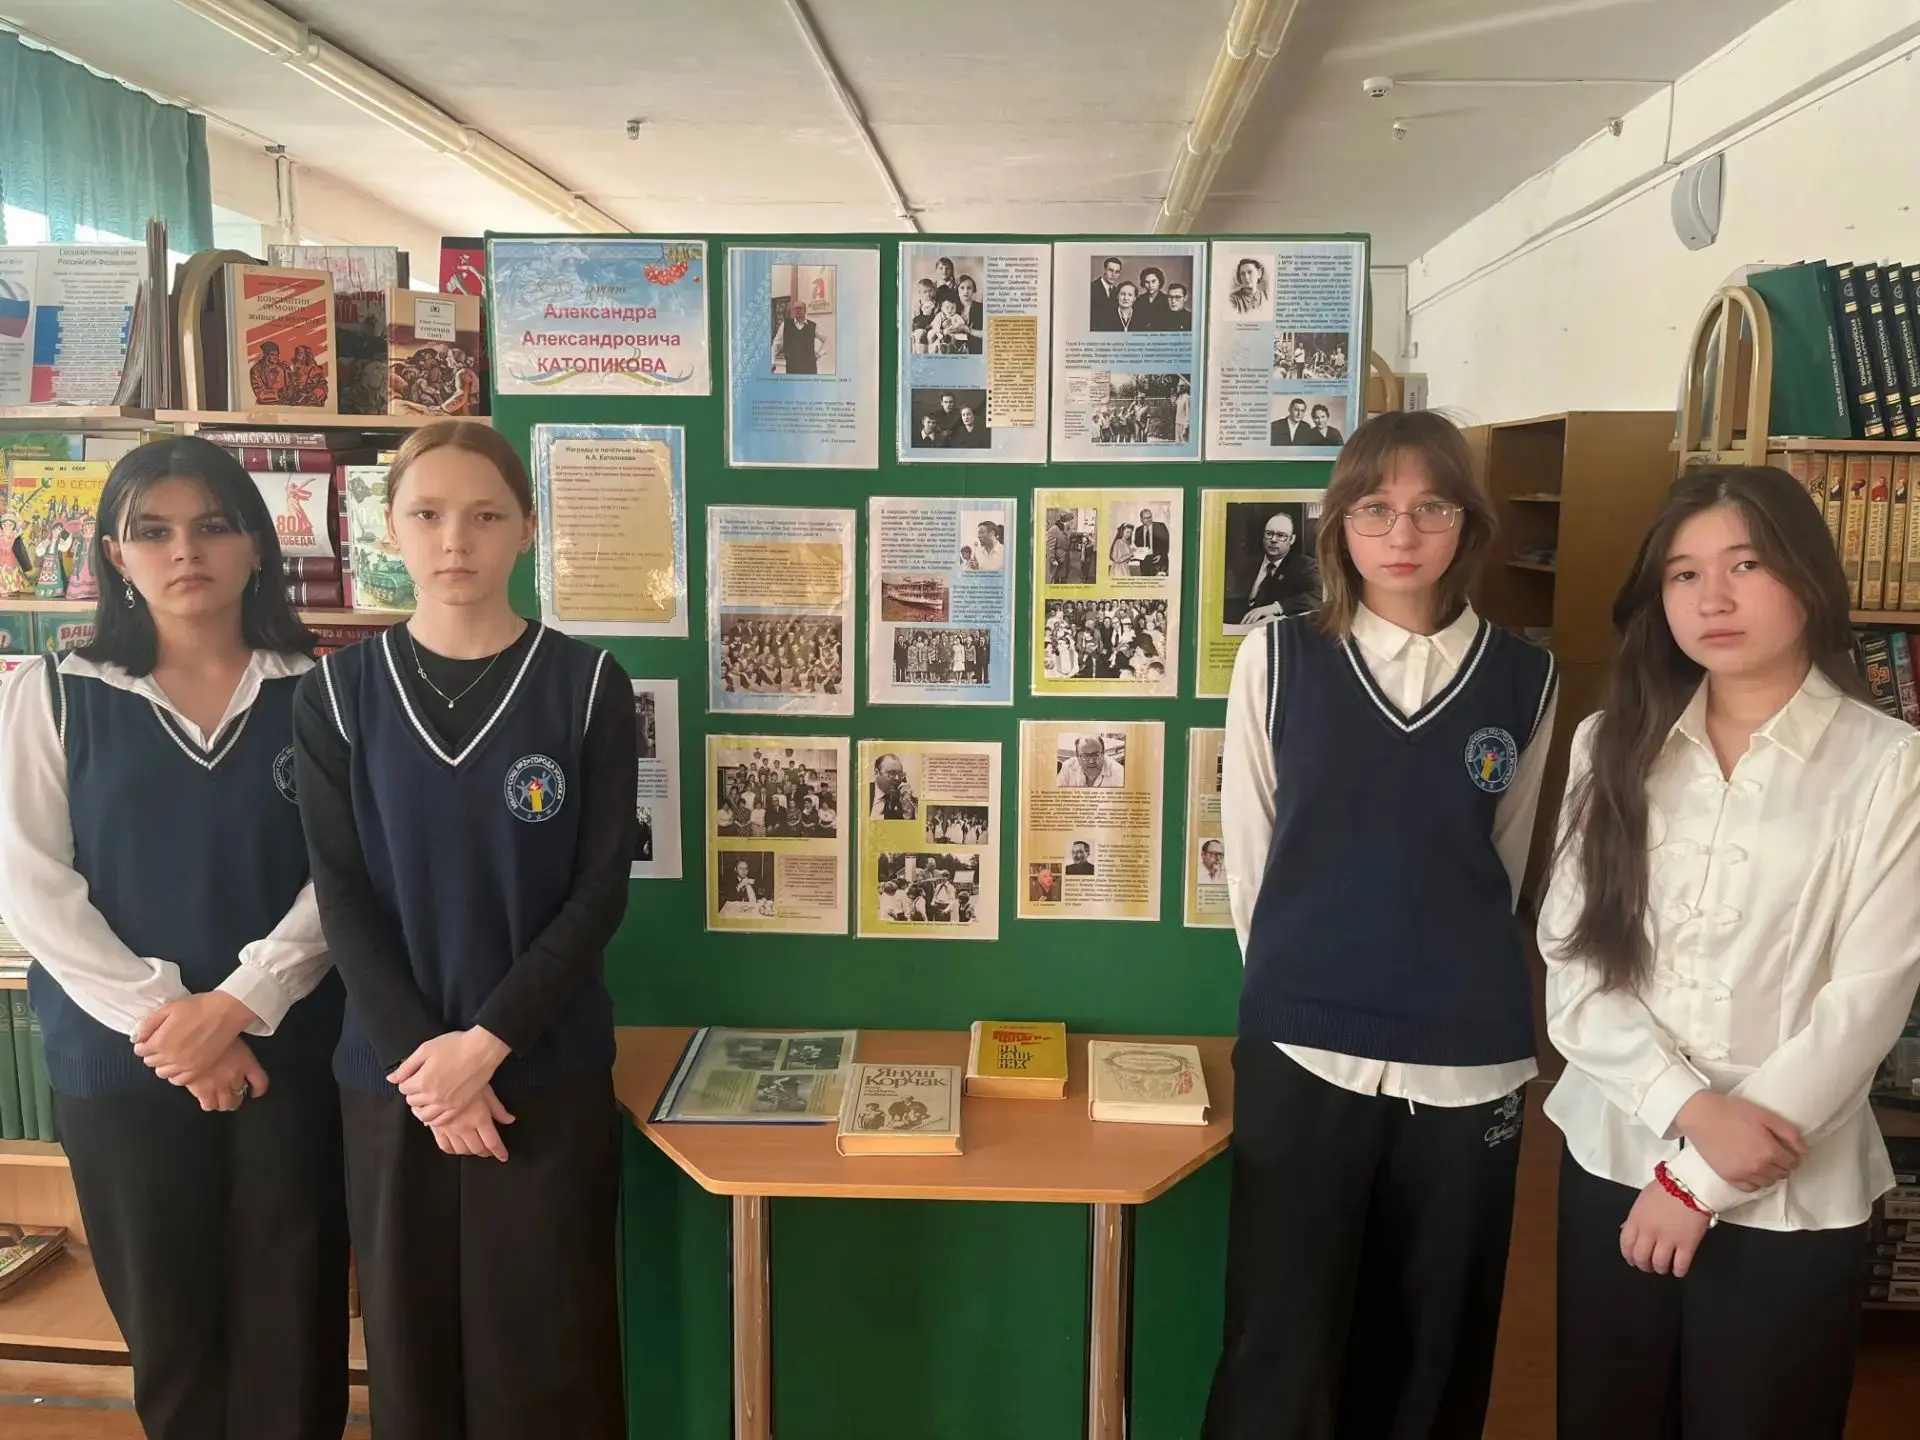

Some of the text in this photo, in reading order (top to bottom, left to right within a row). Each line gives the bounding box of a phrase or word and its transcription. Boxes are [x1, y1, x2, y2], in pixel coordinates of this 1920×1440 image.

[544, 303, 657, 323] Александра
[521, 330, 681, 349] Александровича
[1877, 319, 1888, 357] РОССИЙСКАЯ
[1901, 320, 1912, 358] РОССИЙСКАЯ
[1850, 318, 1867, 386] БОЛЬШАЯ РОССИЙСКАЯ
[537, 357, 668, 373] КАТОЛИКОВА
[1884, 358, 1893, 386] БОЛЬШАЯ
[1908, 359, 1917, 387] БОЛЬШАЯ
[1896, 404, 1903, 414] 2
[276, 515, 297, 535] 80
[1869, 504, 1879, 556] ШКОЛЬНАЯ
[865, 1075, 946, 1089] Корчак
[873, 1068, 935, 1080] Януш
